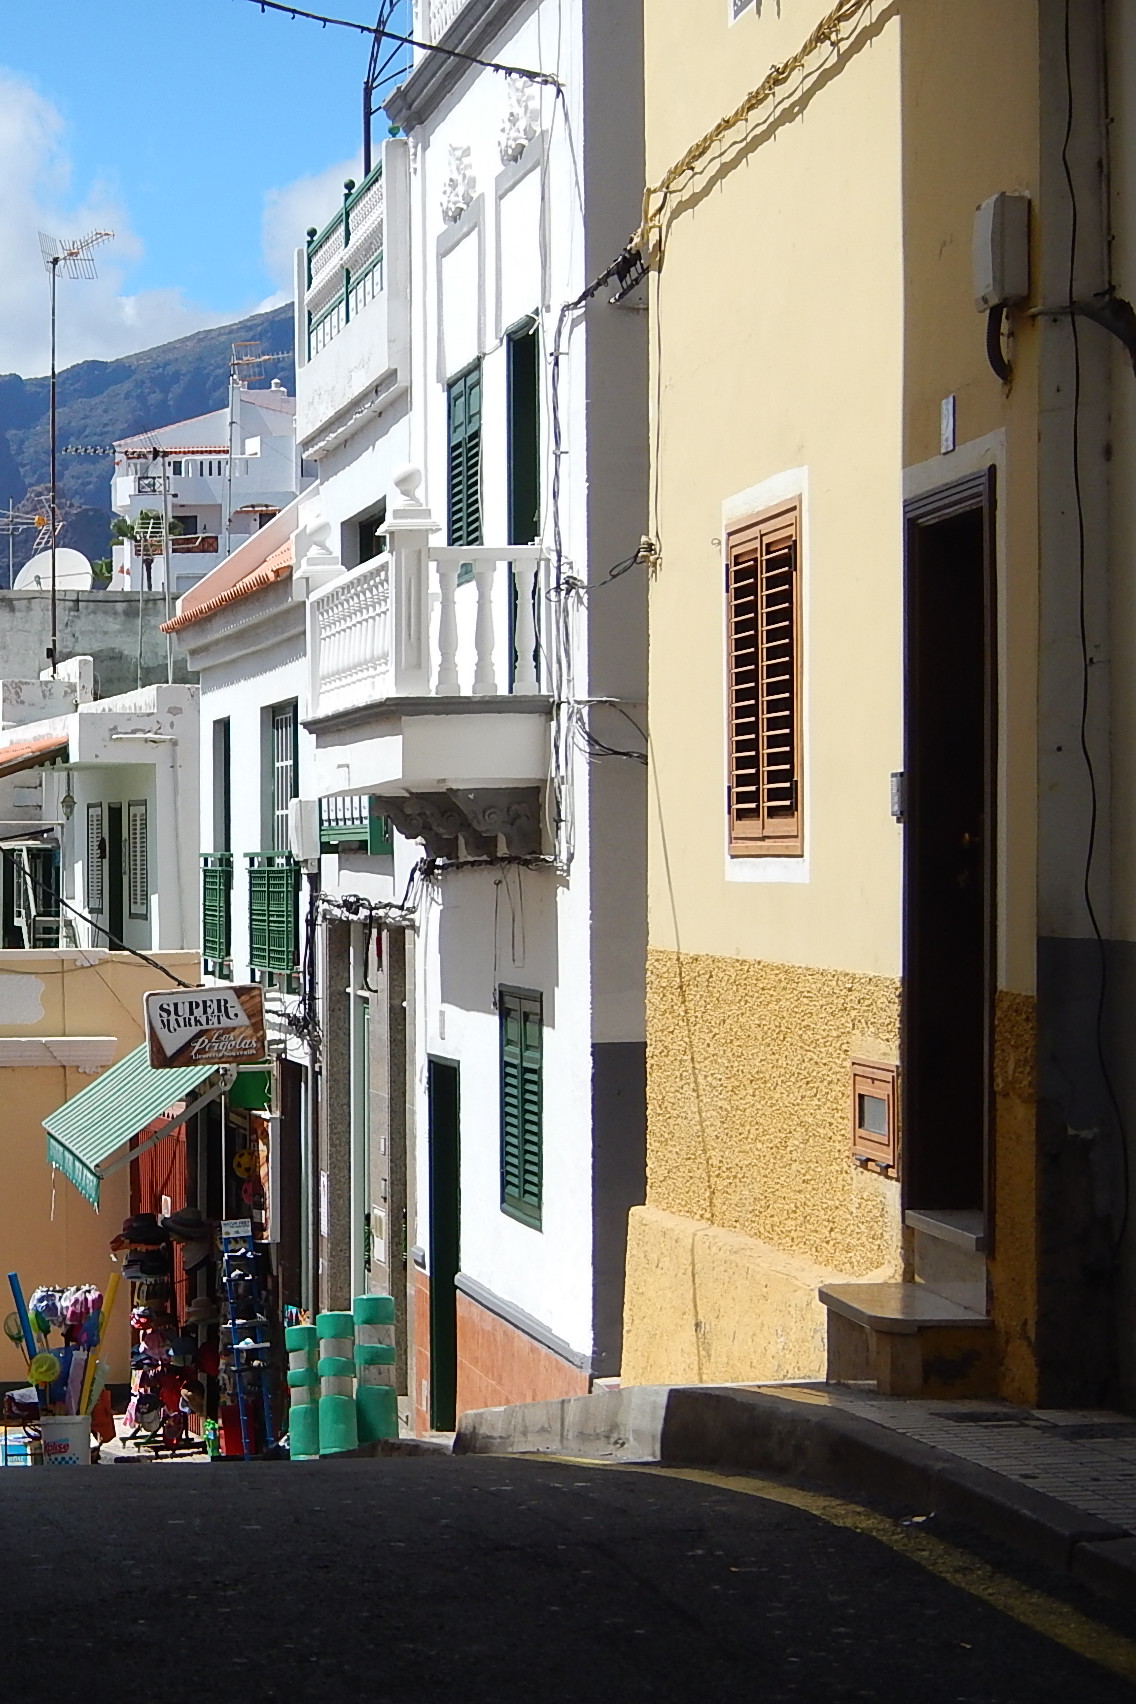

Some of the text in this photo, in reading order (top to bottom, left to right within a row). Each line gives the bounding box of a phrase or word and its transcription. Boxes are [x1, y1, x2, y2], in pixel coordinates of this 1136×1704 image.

[159, 998, 238, 1020] SUPER-
[160, 1015, 224, 1033] MARKET
[191, 1034, 257, 1055] Pergolas
[212, 1029, 235, 1042] Las
